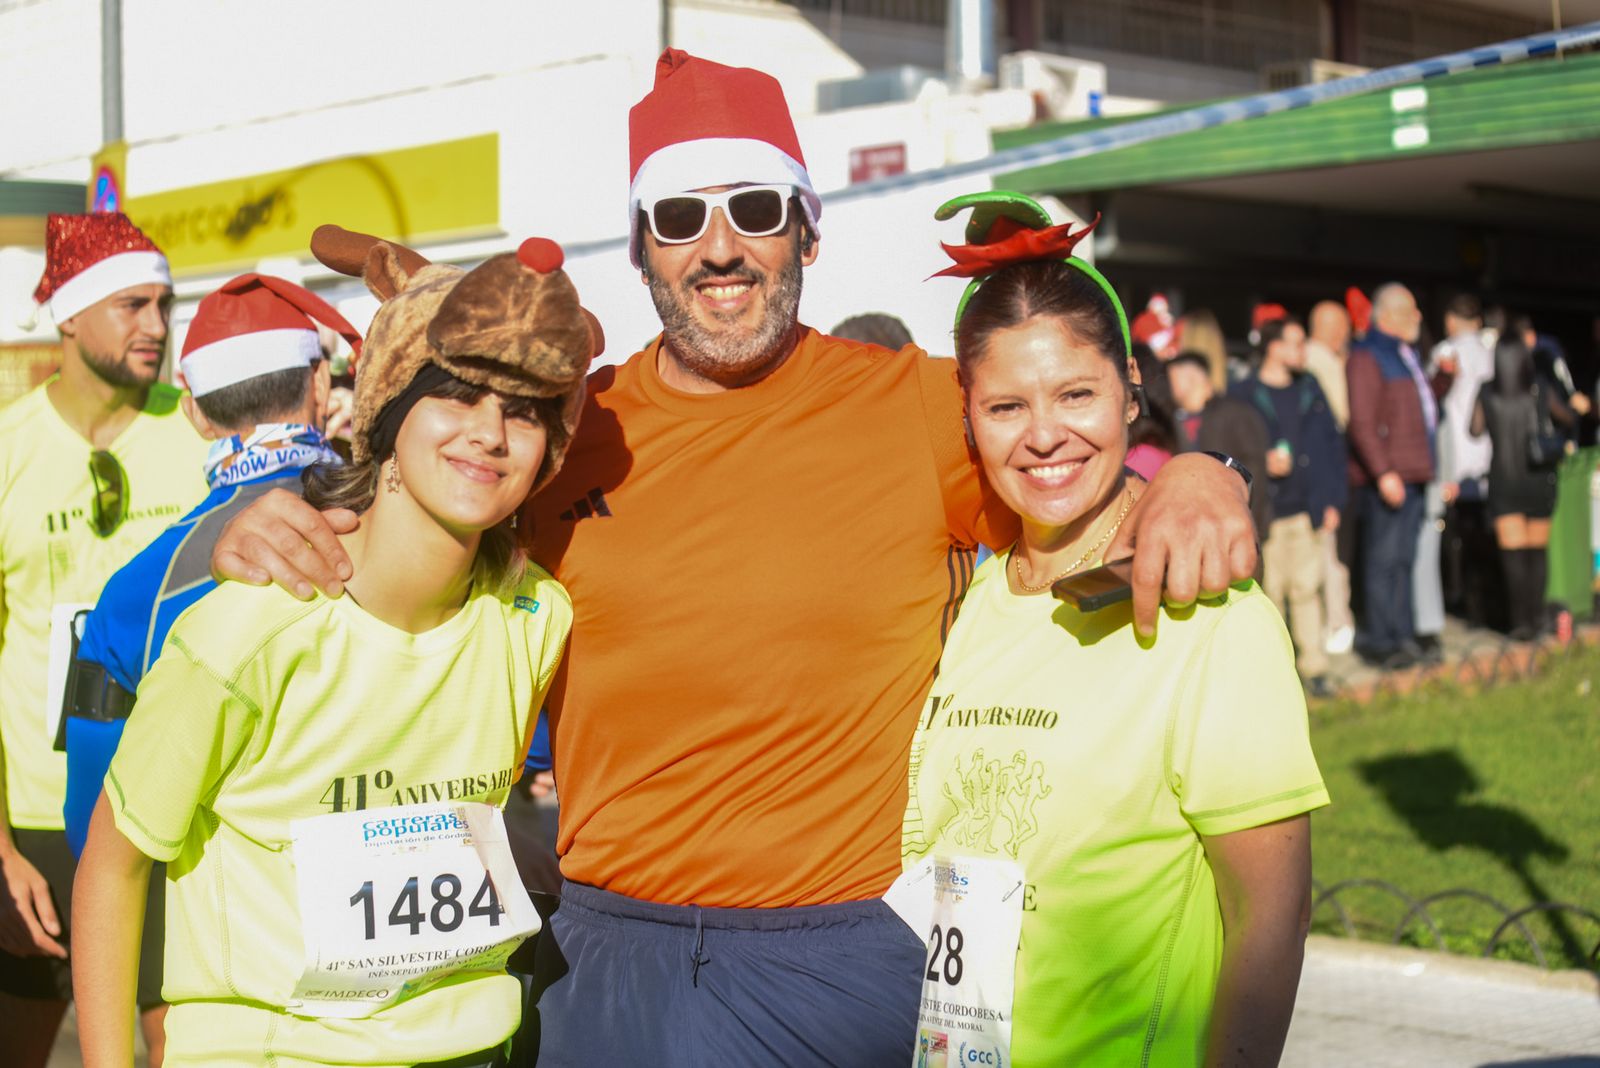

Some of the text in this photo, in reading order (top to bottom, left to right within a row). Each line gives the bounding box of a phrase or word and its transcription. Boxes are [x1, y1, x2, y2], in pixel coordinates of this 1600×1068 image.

[319, 767, 514, 814] 41º ANIVERSARI
[362, 812, 458, 830] carreras
[364, 819, 469, 842] populares
[350, 869, 506, 941] 1484
[326, 960, 345, 972] 41º
[347, 957, 375, 970] SAN
[377, 948, 451, 967] SILVESTRE
[324, 989, 389, 999] IMDECO
[943, 1002, 1004, 1021] CORDOBESA
[957, 1022, 984, 1033] MORAL
[968, 1049, 993, 1065] GCC
